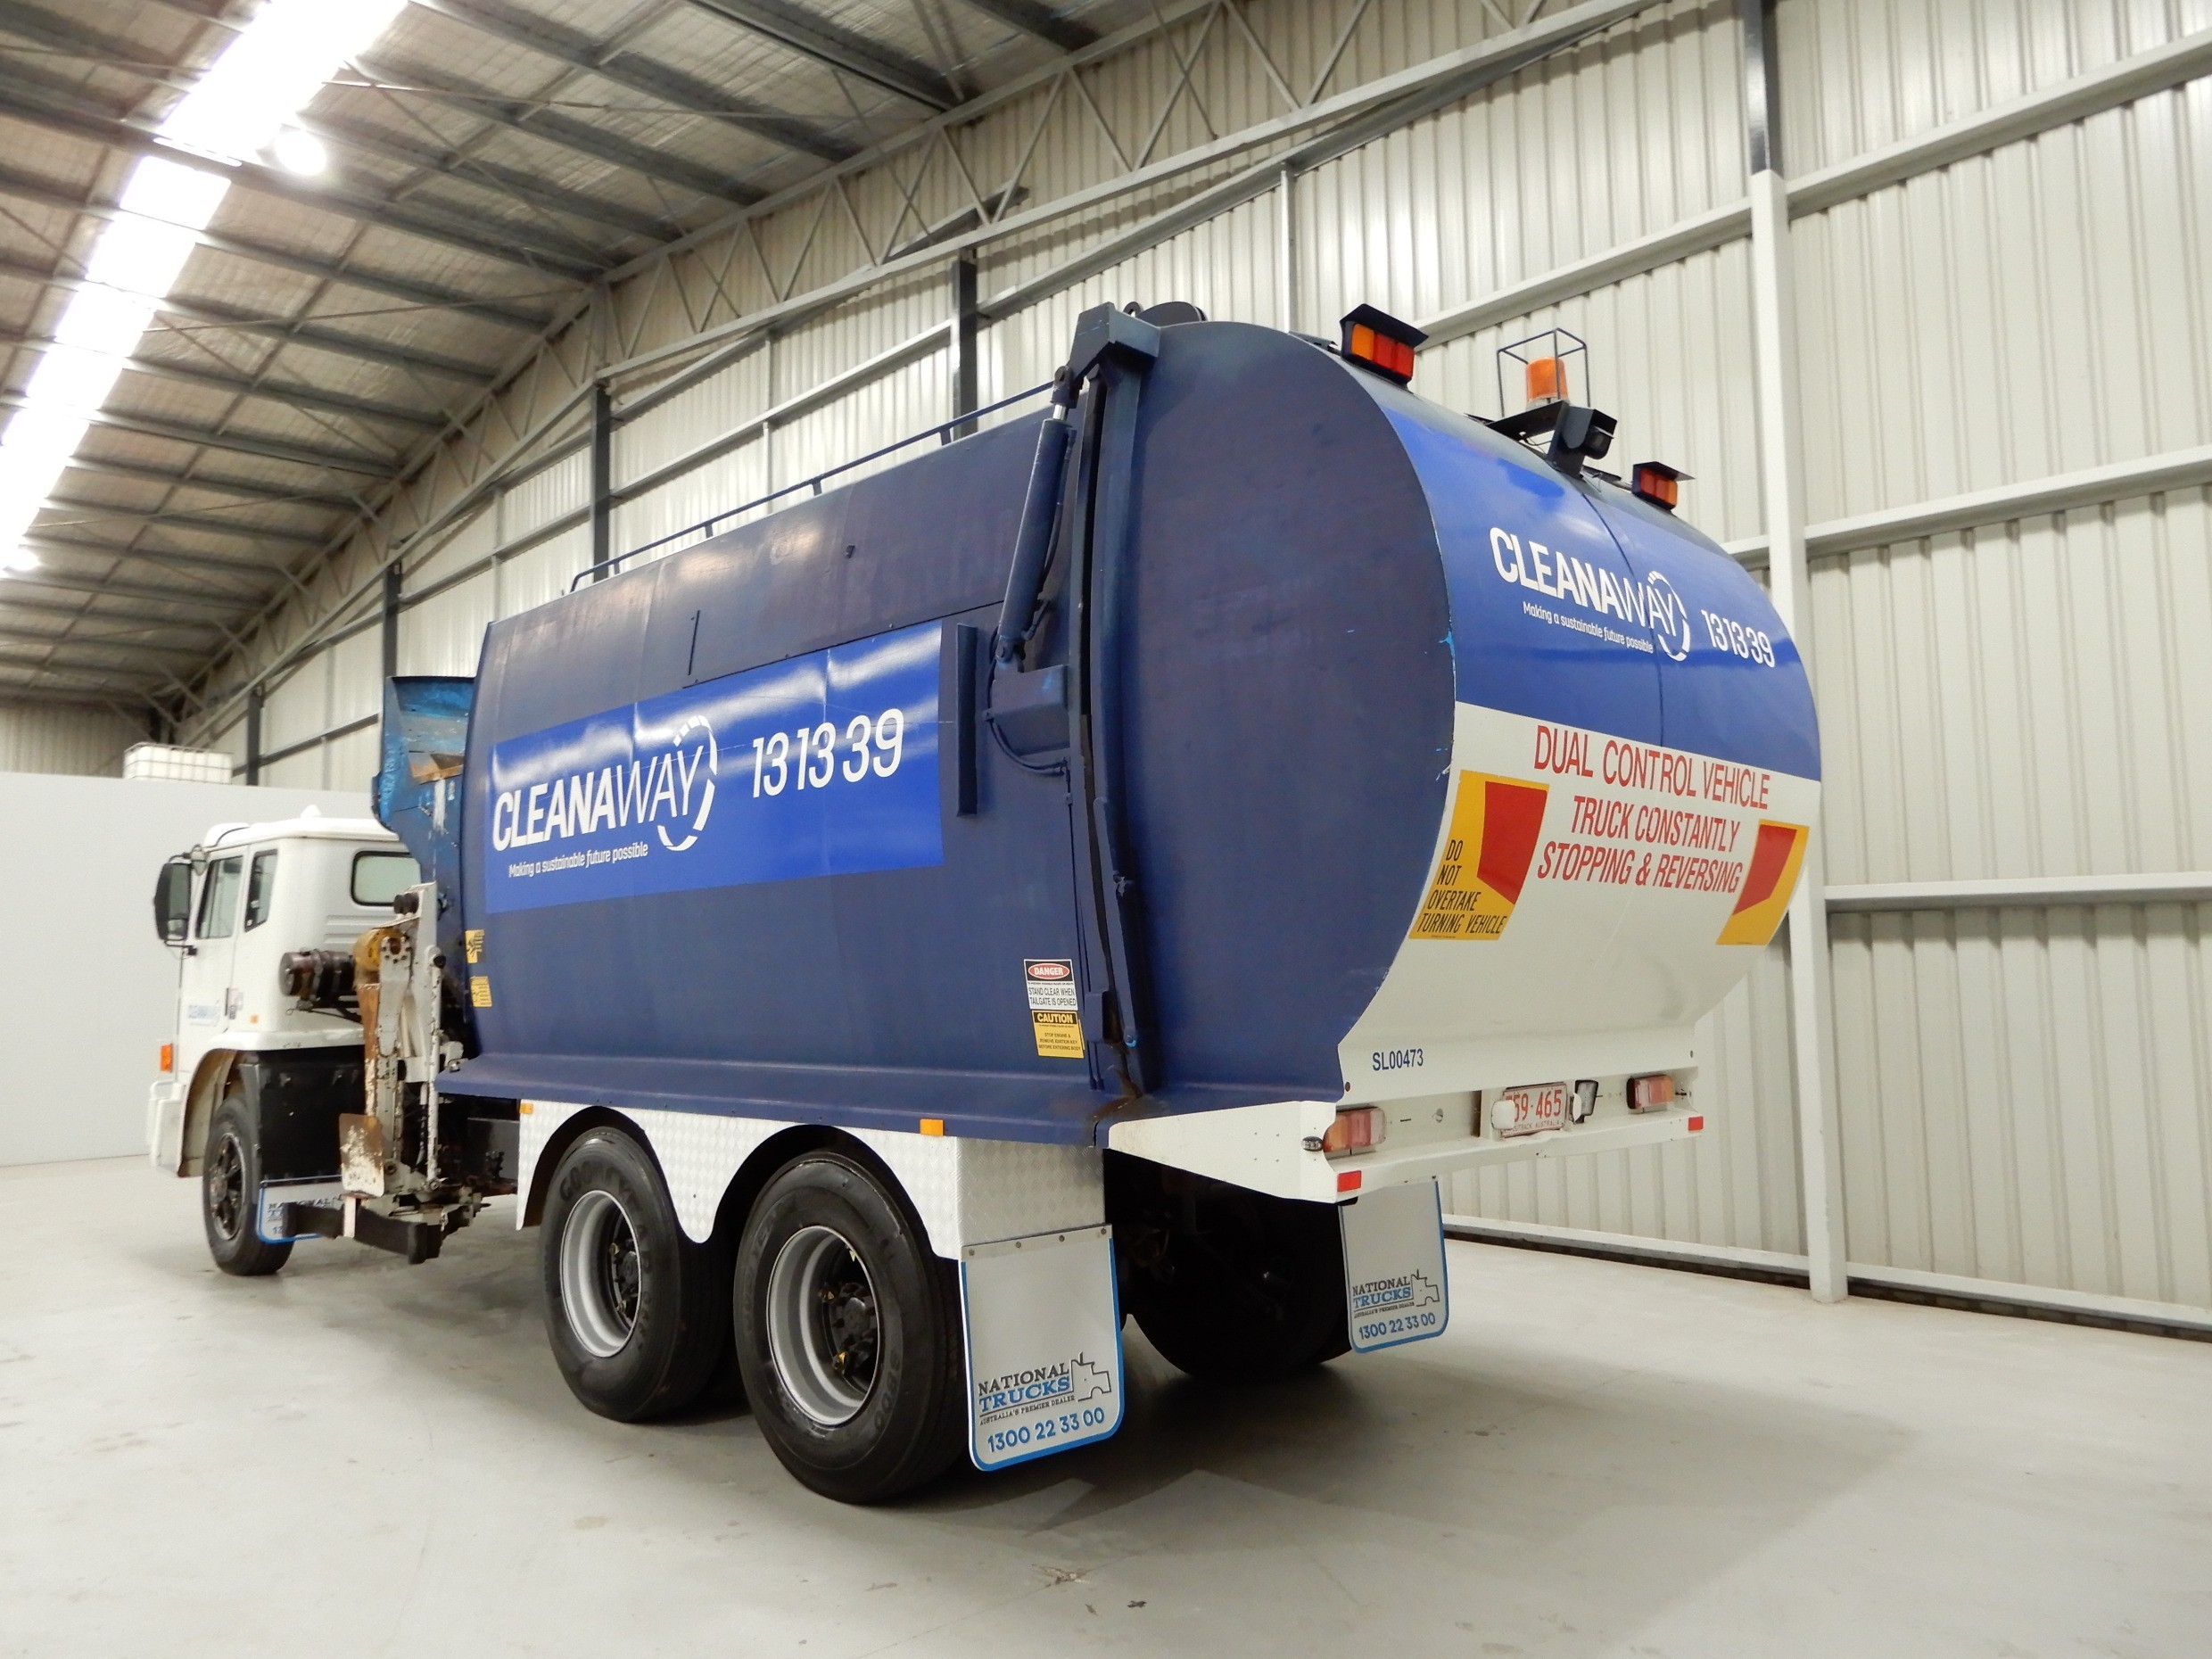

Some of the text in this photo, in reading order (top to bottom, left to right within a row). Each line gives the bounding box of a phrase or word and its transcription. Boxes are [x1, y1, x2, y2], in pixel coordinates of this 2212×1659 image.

[1490, 527, 1677, 637] CLEANAWAY
[1523, 601, 1654, 654] Making a sustainable future possible
[1534, 724, 1770, 810] DUAL CONTROL VEHICLE
[492, 746, 704, 852] CLEANAWAY
[1570, 795, 1741, 853] TRUCK CONSTANTLY
[508, 841, 648, 878] Making a sustainable future possible
[1446, 839, 1464, 862] DO
[1436, 864, 1463, 886] NOT
[1536, 840, 1744, 894] STOPPING & REVERSING
[1427, 889, 1482, 911] OVERTAKE
[1417, 912, 1508, 934] TURNING VEHICLE
[1034, 967, 1064, 976] DANGER
[1028, 987, 1075, 996] STAND CLEAR WHEN
[1029, 997, 1076, 1006] TAILGATE IS OPENED
[1036, 1013, 1073, 1024] CAUTION
[1372, 1048, 1424, 1070] SL00473
[1352, 1276, 1410, 1296] NATIONAL
[1353, 1287, 1411, 1308] TRUCKS
[1358, 1312, 1436, 1339] 1300 22 33 00
[978, 1363, 1069, 1397] NATIONAL
[978, 1375, 1070, 1412] TRUCKS
[980, 1395, 1076, 1426] AUSTRALIA'S PREMIER DEALER
[987, 1407, 1105, 1453] 1300 22 33 00
